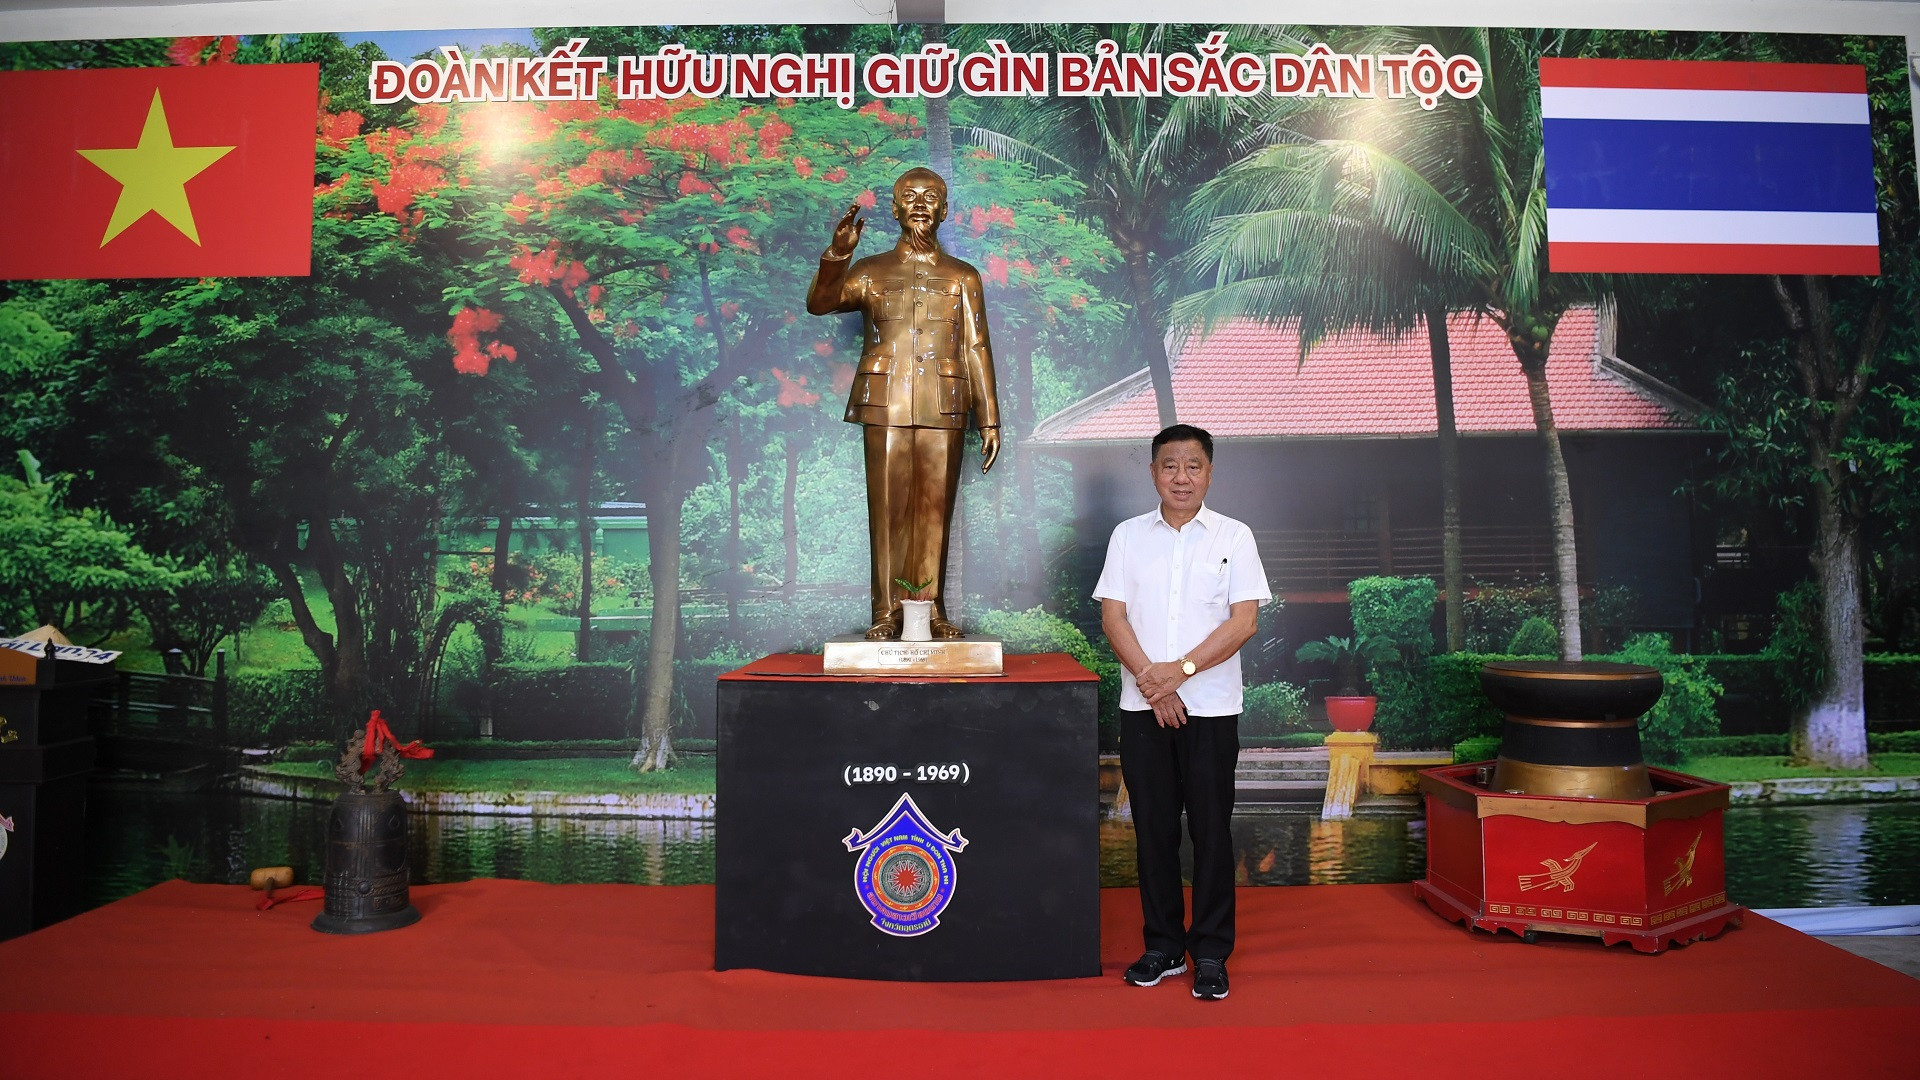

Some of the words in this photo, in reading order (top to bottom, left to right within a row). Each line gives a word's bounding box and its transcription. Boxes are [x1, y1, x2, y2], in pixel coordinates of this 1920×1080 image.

[374, 47, 502, 98] ĐOÀN
[516, 41, 603, 97] KẾT
[622, 49, 723, 95] HỮU
[736, 57, 852, 108] NGHỊ
[867, 48, 955, 94] GIỮ
[963, 43, 1044, 93] GÌN
[1062, 43, 1159, 93] BẢN
[1168, 34, 1262, 93] SẮC
[1275, 47, 1369, 94] DÂN
[1382, 48, 1479, 106] TỘC
[844, 765, 898, 786] (1890
[917, 762, 970, 784] 1969)
